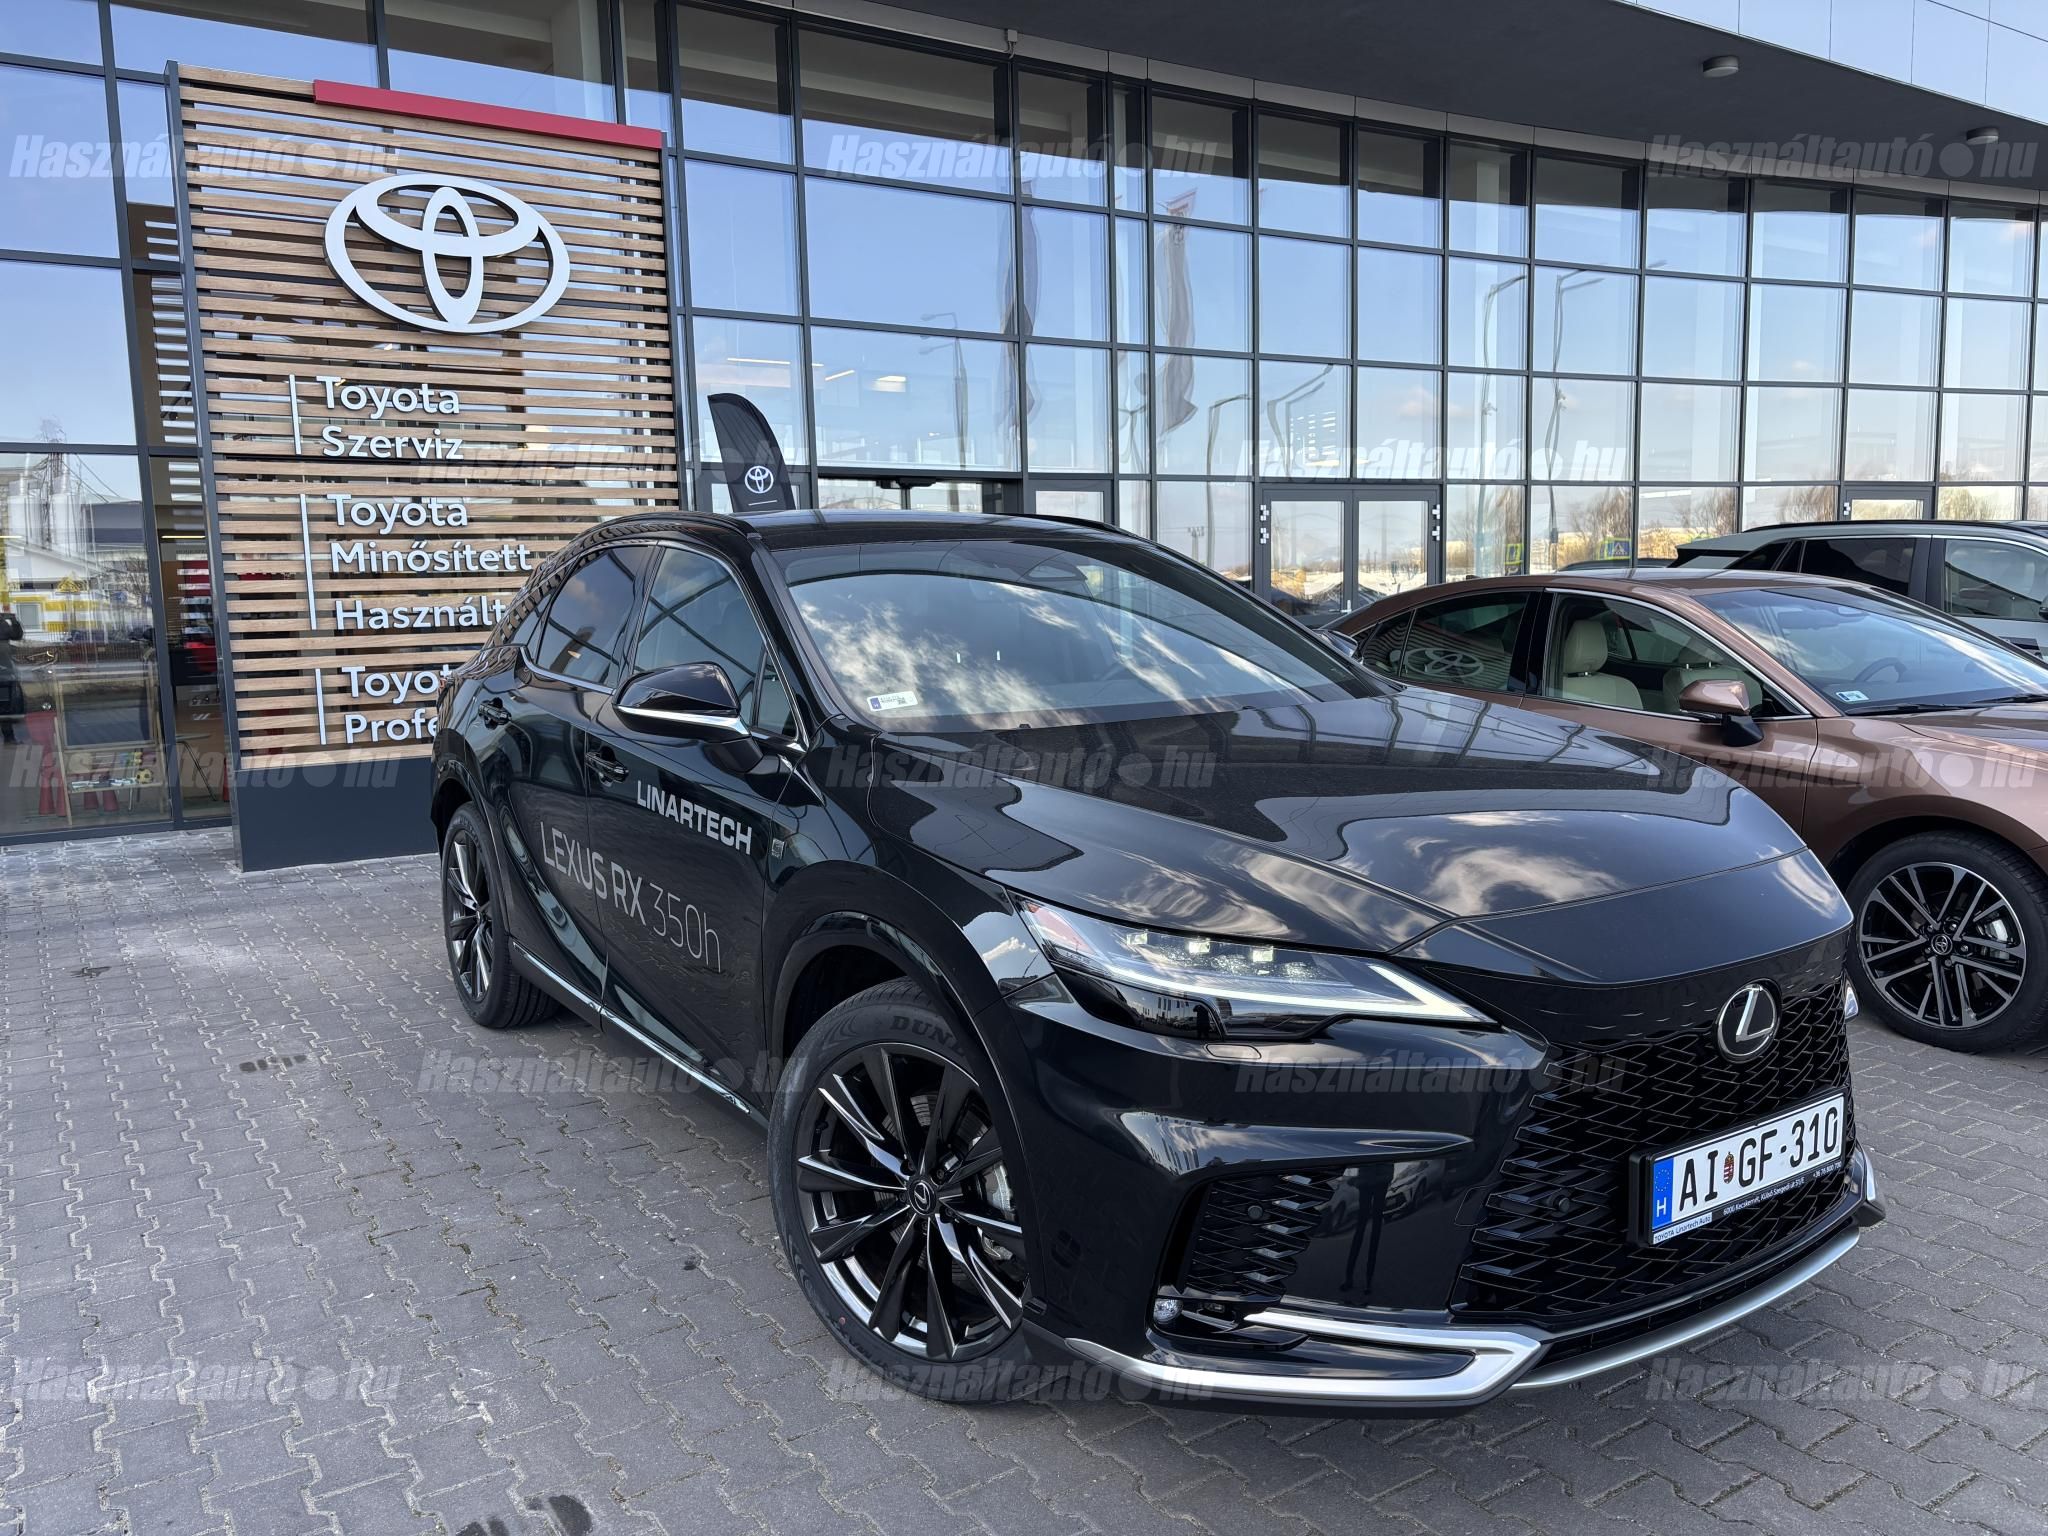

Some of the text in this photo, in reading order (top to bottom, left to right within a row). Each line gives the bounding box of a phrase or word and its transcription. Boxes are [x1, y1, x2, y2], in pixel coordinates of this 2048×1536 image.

[316, 375, 460, 419] Toyota
[322, 425, 464, 460] Szerviz
[326, 493, 469, 534] Toyota
[330, 540, 532, 574] Minősített
[335, 595, 506, 631] Használt
[637, 780, 752, 855] LINARTECH
[540, 821, 721, 973] LEXUS RX 350h
[1656, 1197, 1667, 1218] H
[1654, 1215, 1711, 1242] TOYOTA Linartech Auto
